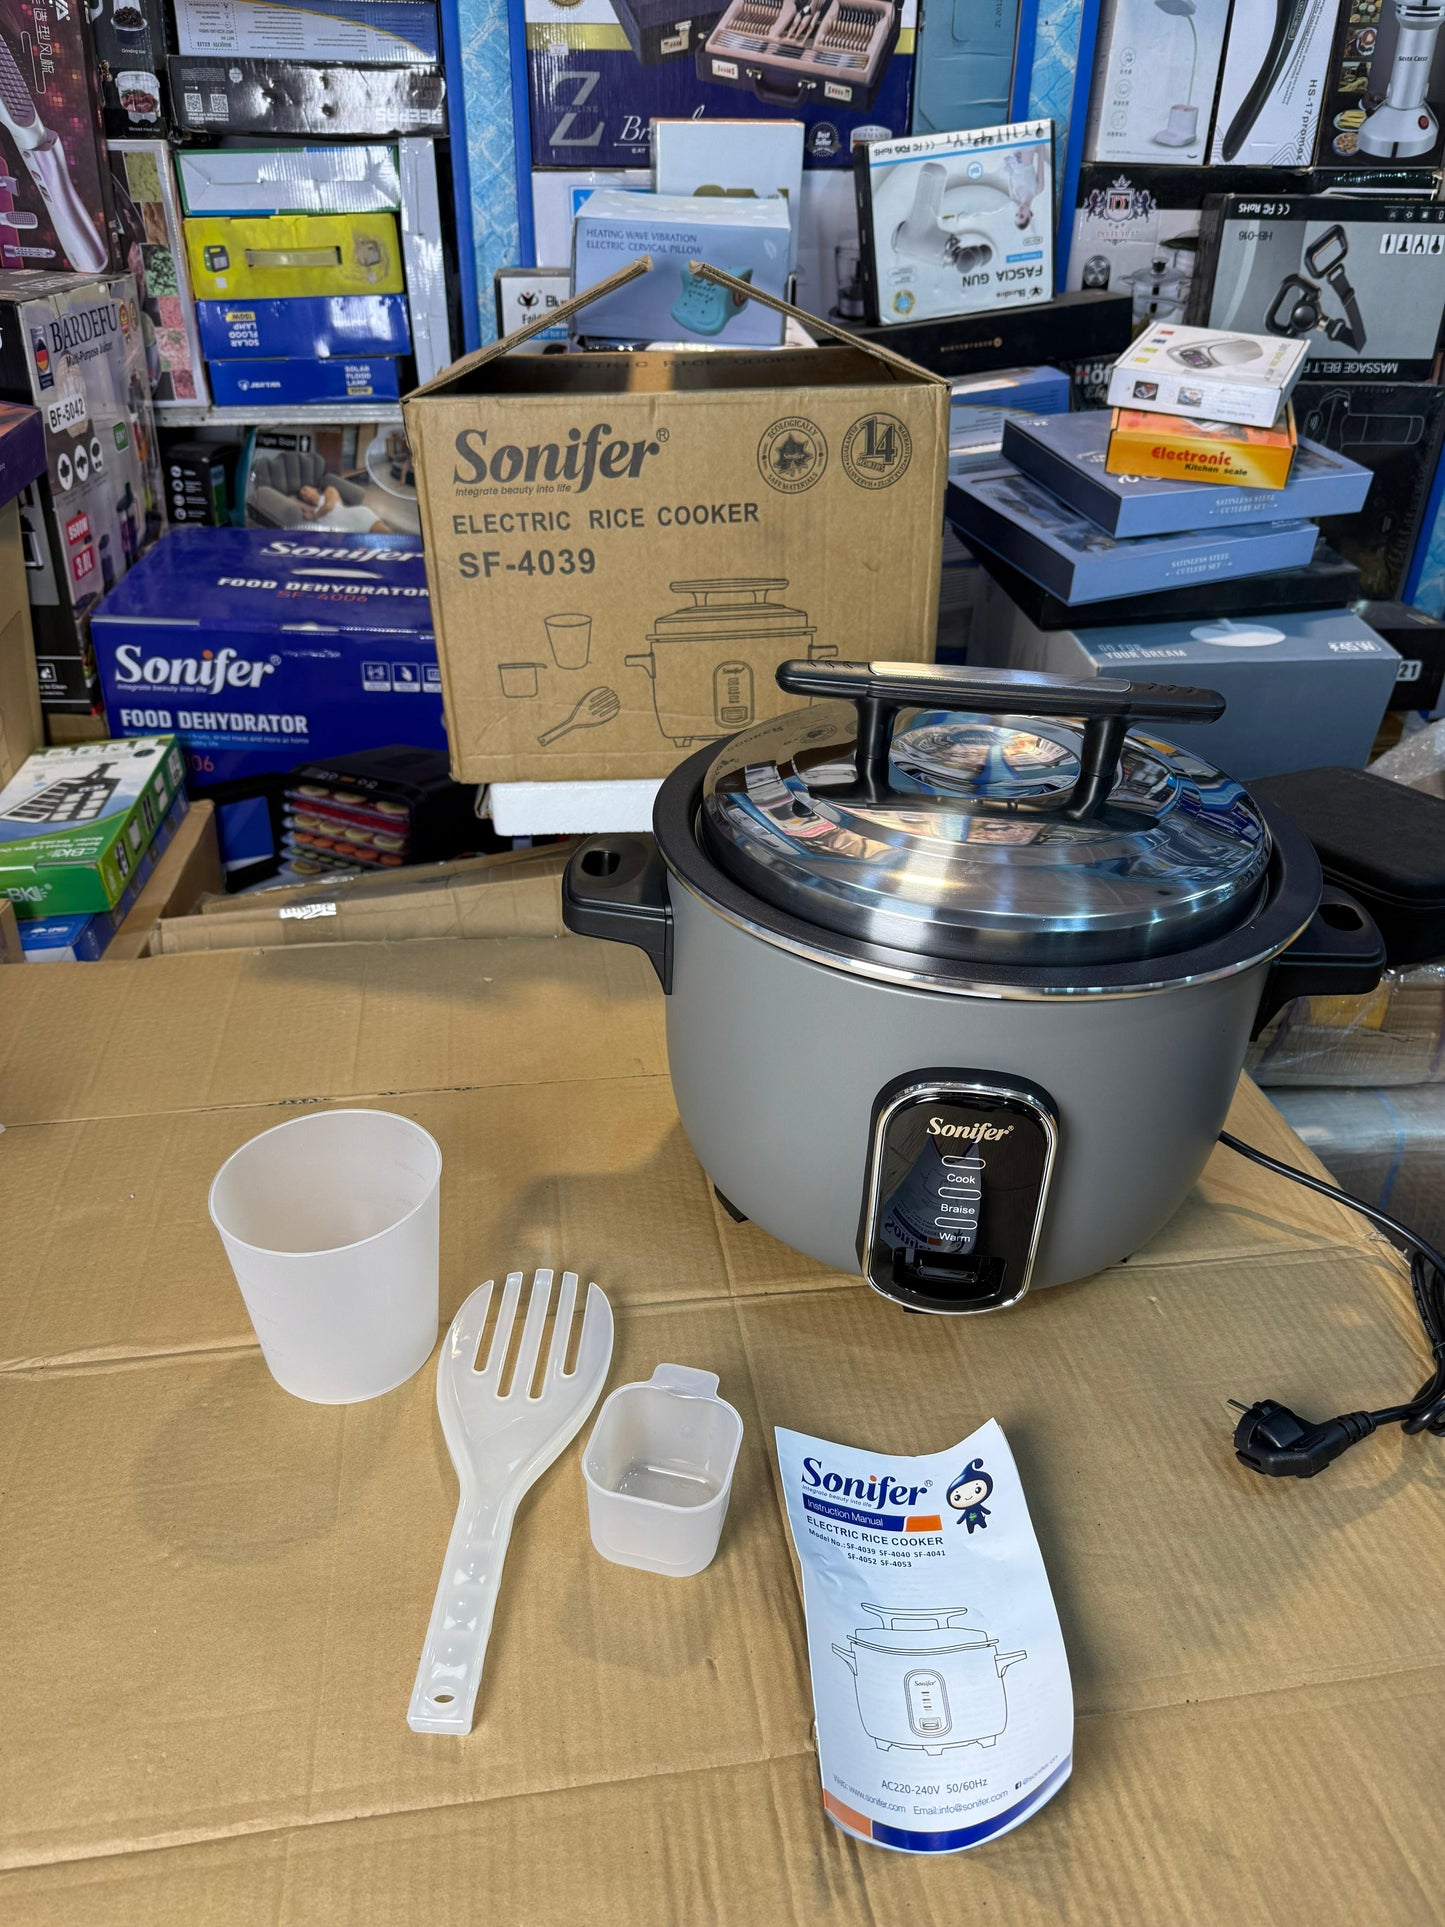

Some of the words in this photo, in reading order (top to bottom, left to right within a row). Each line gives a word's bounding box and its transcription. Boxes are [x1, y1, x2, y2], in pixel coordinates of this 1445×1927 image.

[1296, 79, 1318, 161] HS-17promax
[586, 229, 624, 240] HEATING
[626, 231, 649, 241] WAVE
[651, 232, 697, 243] VIBRATION
[1238, 230, 1273, 240] HB-016
[586, 240, 625, 250] ELECTRIC
[628, 242, 666, 253] CERVICAL
[669, 244, 704, 255] PILLOW
[962, 272, 990, 287] GUN
[996, 265, 1043, 282] FASCIA
[49, 303, 118, 354] BARDEFU
[229, 331, 258, 339] FLOOD
[230, 339, 260, 347] SOLAR
[1310, 362, 1342, 374] BELT
[1344, 362, 1398, 374] MASSAGE
[50, 398, 85, 428] BF-5042
[767, 420, 819, 439] ECOLOGICALLY
[860, 416, 898, 466] 14
[452, 422, 660, 494] Sonifer
[856, 458, 886, 473] MONTHS
[1152, 446, 1232, 466] Electronic
[1184, 464, 1218, 473] Kitchen
[1224, 468, 1248, 476] scale
[455, 486, 498, 498] Integrate
[500, 485, 534, 497] beauty
[536, 484, 555, 494] into
[558, 483, 571, 493] life
[452, 510, 572, 535] ELECTRIC
[588, 507, 644, 530] RICE
[657, 502, 760, 526] COOKER
[261, 540, 424, 562] Sonifer
[458, 548, 597, 579] SF-4039
[217, 577, 278, 590] FOOD
[285, 582, 430, 598] DEHYDRATOR
[1140, 648, 1187, 658] DREAM
[115, 644, 276, 695] Sonifer
[120, 708, 172, 728] FOOD
[178, 710, 309, 734] DEHYDRATOR
[926, 1116, 1010, 1142] Sonifer
[946, 1173, 976, 1184] Cook
[940, 1204, 976, 1214] Braise
[938, 1232, 971, 1242] Warm
[801, 1457, 928, 1510] Sonifer
[802, 1485, 828, 1498] Integrate
[828, 1492, 850, 1504] beauty
[807, 1498, 850, 1519] Instruction
[851, 1511, 884, 1527] Manual
[806, 1515, 858, 1540] ELECTRIC
[862, 1533, 888, 1546] RICE
[893, 1536, 944, 1546] COOKER
[808, 1528, 830, 1542] Model
[879, 1550, 911, 1558] SF-4040
[914, 1550, 946, 1558] SF-4041
[847, 1552, 878, 1565] SF-4052
[880, 1560, 912, 1568] SF-4053
[881, 1778, 940, 1795] AC220-240V
[946, 1778, 988, 1794] 50/60Hz
[913, 1790, 1009, 1816] Email:info@sonifer.com
